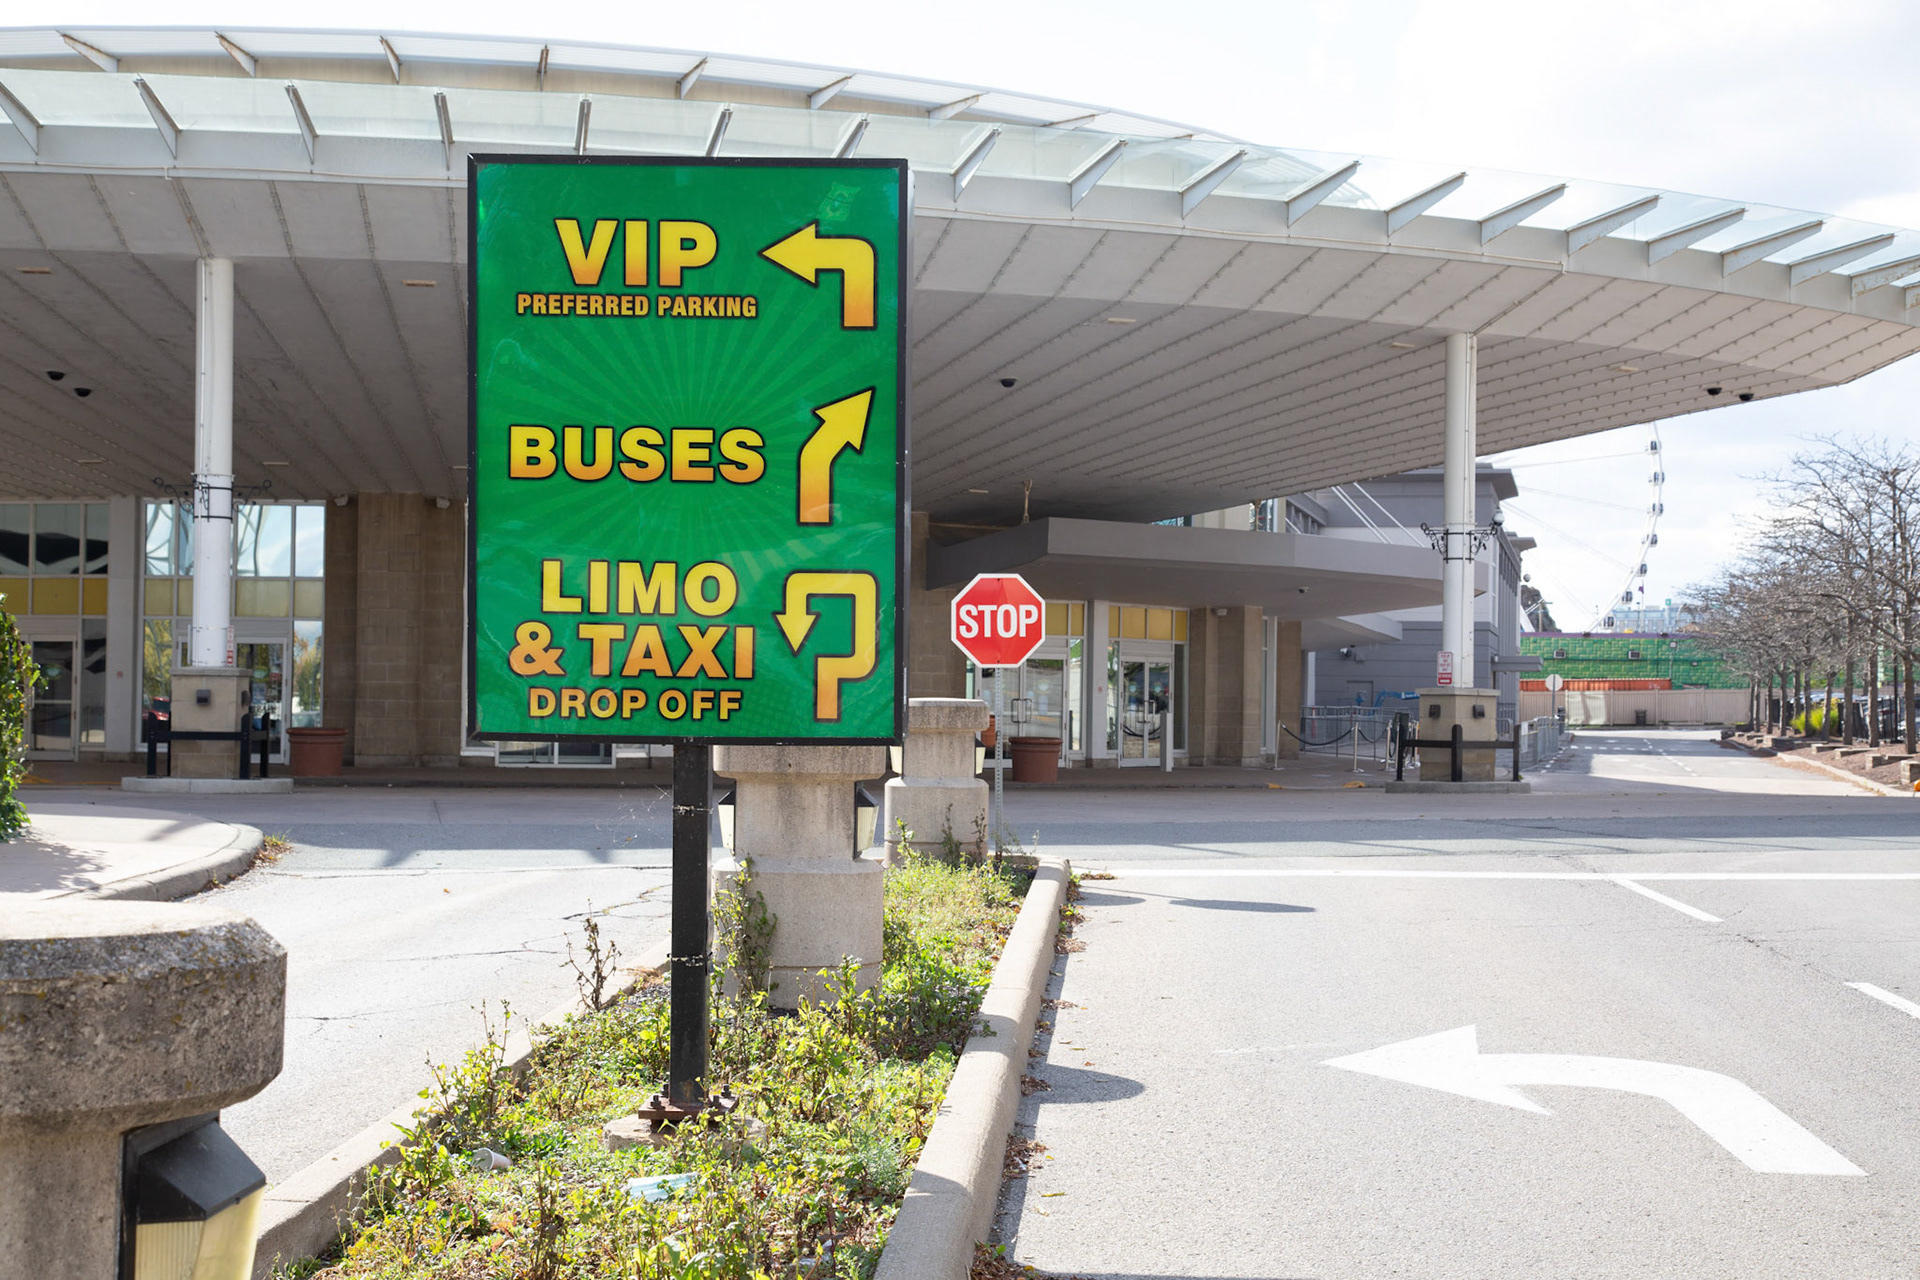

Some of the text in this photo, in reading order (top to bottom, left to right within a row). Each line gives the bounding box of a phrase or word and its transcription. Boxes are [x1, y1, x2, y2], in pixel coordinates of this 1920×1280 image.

[554, 218, 719, 287] VIP
[517, 294, 758, 318] PREFERRED PARKING
[508, 424, 766, 484] BUSES
[541, 559, 738, 617] LIMO
[508, 620, 755, 679] & TAXI
[959, 604, 1038, 638] STOP
[528, 687, 743, 721] DROP OFF
